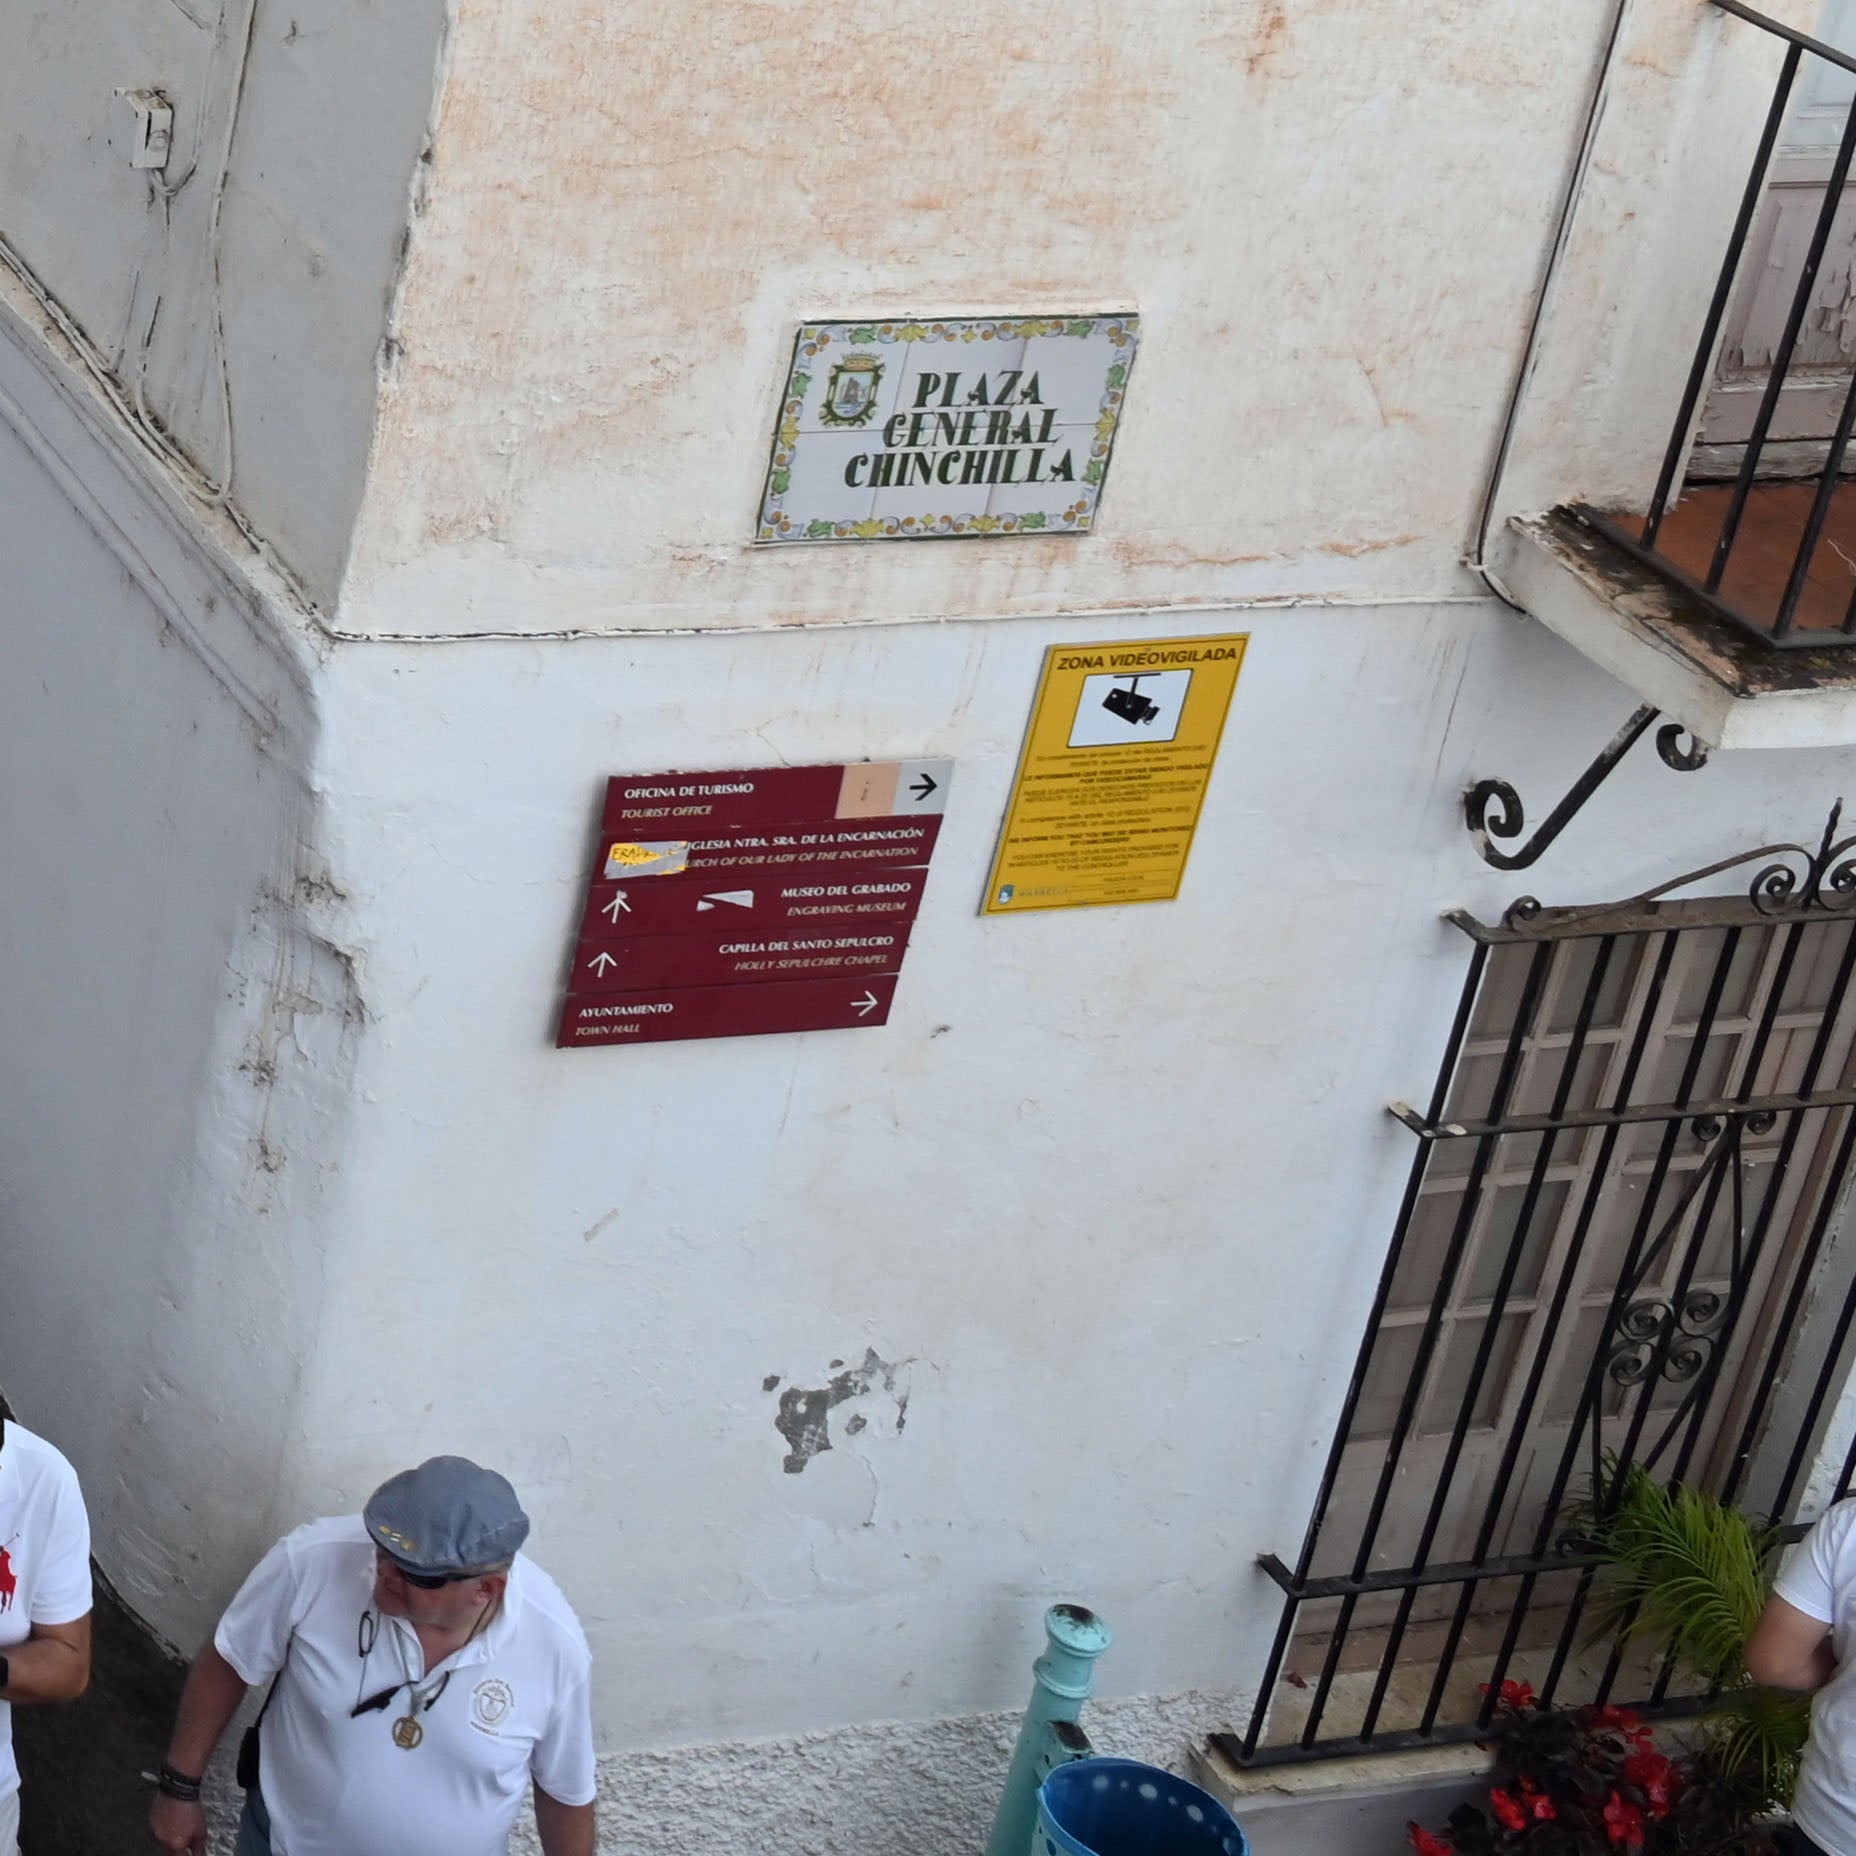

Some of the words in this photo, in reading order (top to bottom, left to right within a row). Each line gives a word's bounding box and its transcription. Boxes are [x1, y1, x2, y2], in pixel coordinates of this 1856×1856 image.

[911, 369, 1044, 409] PLAZA
[882, 408, 1062, 449] GENERAL
[843, 447, 1077, 488] CHINCHILLA
[1057, 655, 1104, 671] ZONA
[1109, 647, 1238, 667] VIDEOVIGILADA
[624, 786, 676, 799] OFICINA
[679, 785, 696, 797] DE
[698, 782, 755, 795] TURISMO
[621, 807, 670, 819] TOURIST
[672, 805, 713, 816] OFFICE
[734, 837, 769, 848] NTRA.
[772, 836, 798, 846] SRA.
[800, 834, 818, 845] DE
[819, 833, 835, 843] LA
[837, 827, 925, 843] ENCARNACIÓN
[720, 856, 737, 866] OF
[738, 855, 765, 865] OUR
[767, 853, 798, 863] LADY
[798, 852, 816, 862] OF
[816, 851, 838, 860] THE
[839, 847, 919, 860] INCARNATION
[781, 886, 825, 898] MUSEO
[826, 885, 849, 896] DEL
[851, 882, 912, 895] GRABADO
[786, 904, 854, 916] ENGRAVING
[855, 902, 906, 913] MUSEUM
[719, 942, 765, 954] CAPILLA
[768, 940, 790, 951] DEL
[791, 938, 833, 950] SANTO
[834, 935, 895, 948] SEPULCRO
[734, 959, 775, 971] HOLLY
[845, 954, 888, 966] CHAPEL
[578, 1002, 674, 1018] AYUNTAMIENTO
[575, 1025, 610, 1036] TOWN
[612, 1023, 640, 1034] HALL
